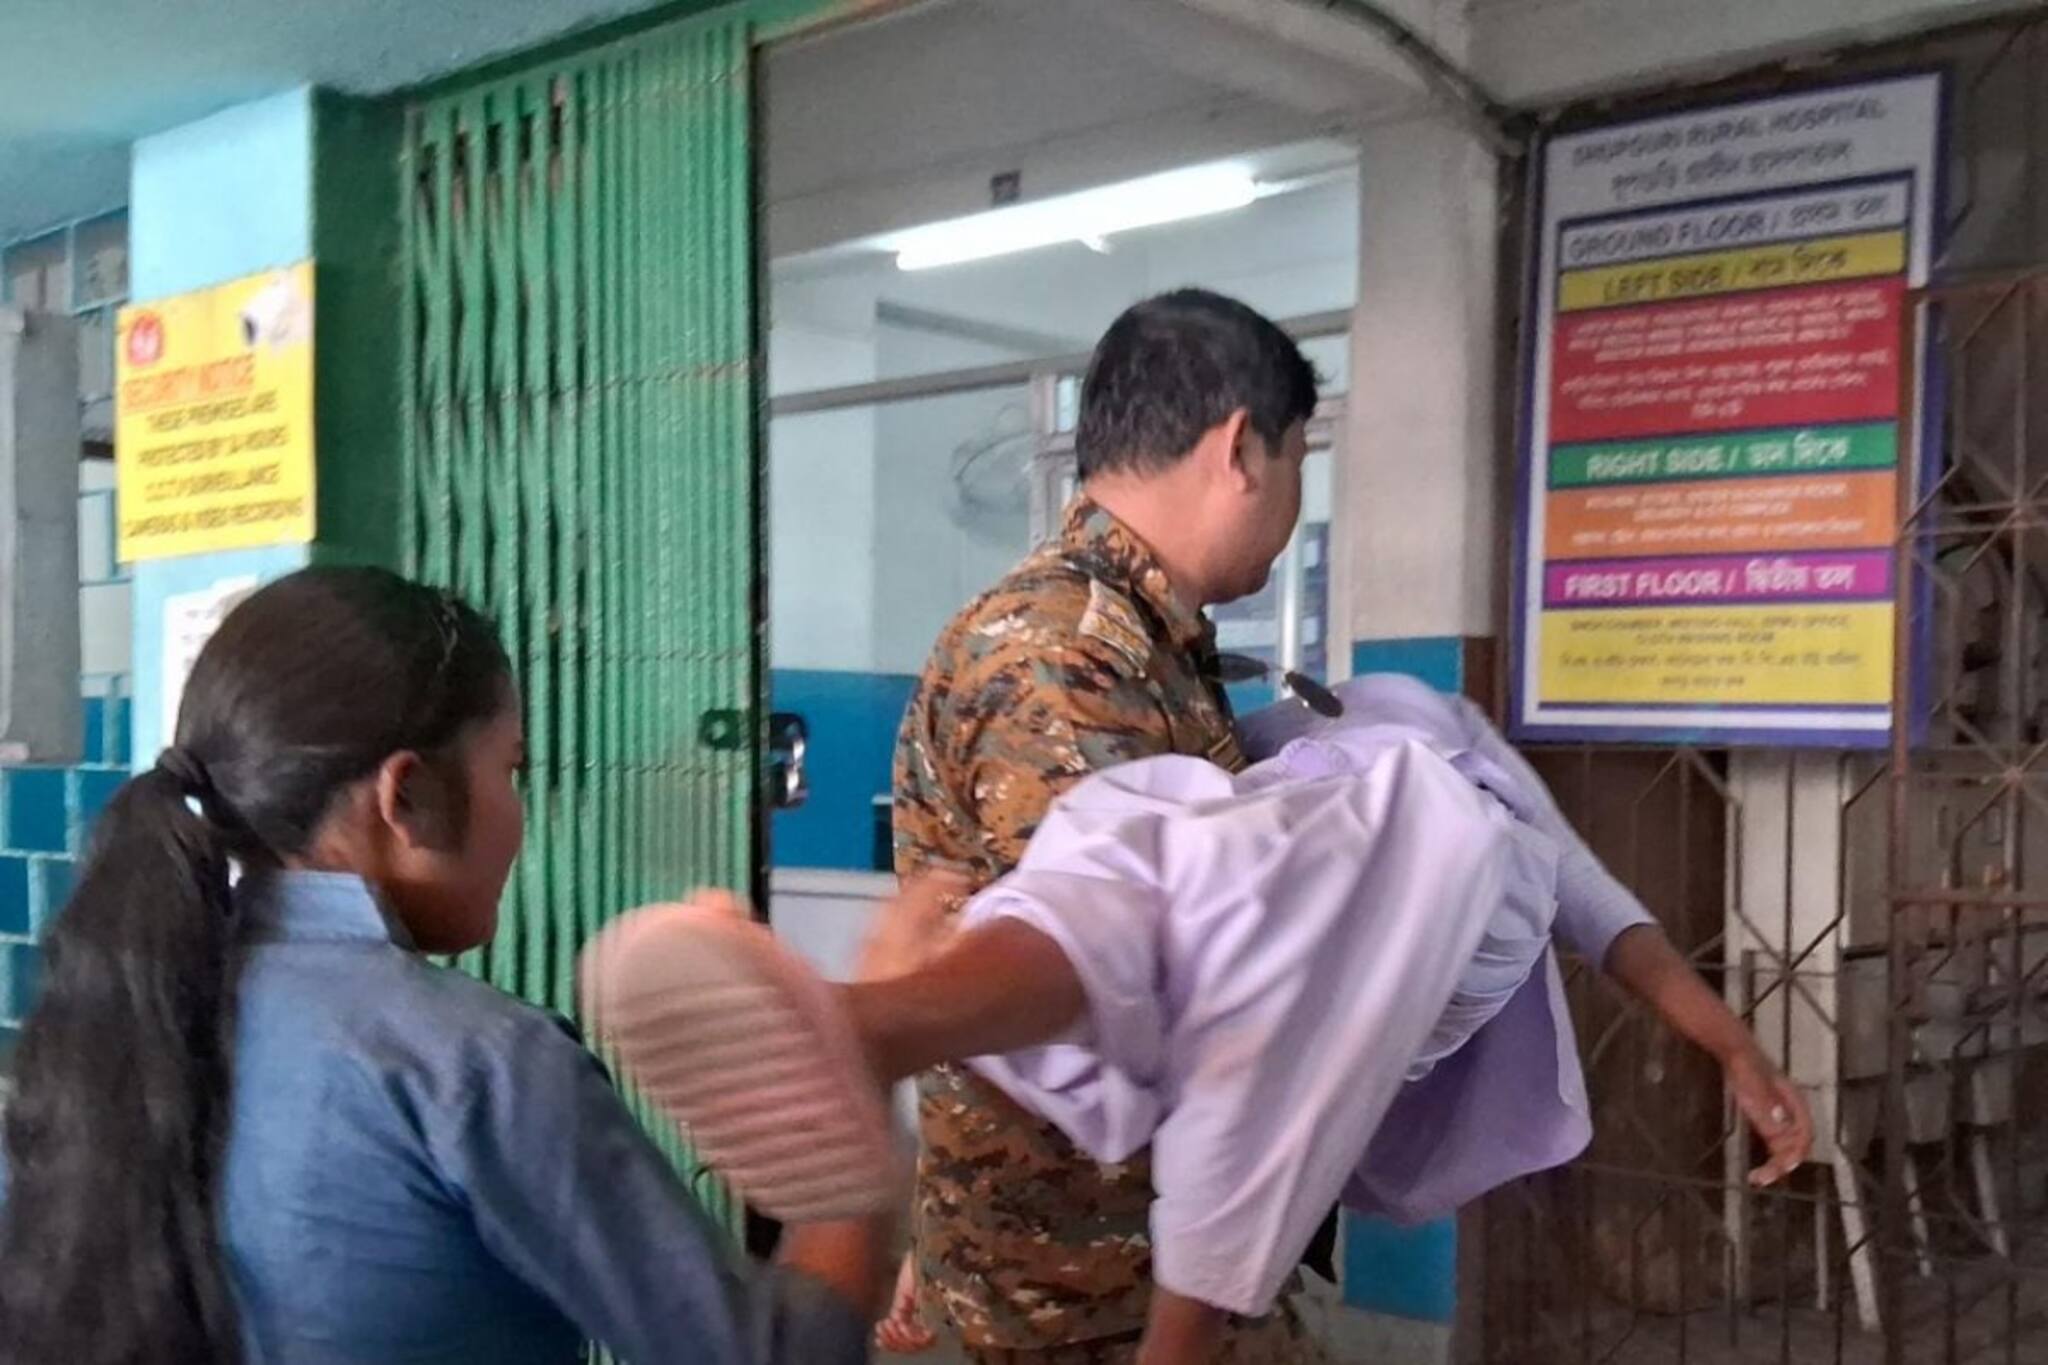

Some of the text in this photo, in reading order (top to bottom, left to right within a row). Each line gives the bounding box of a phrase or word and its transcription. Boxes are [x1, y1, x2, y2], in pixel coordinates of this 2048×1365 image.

[1768, 98, 1887, 136] HOSPITAL
[1568, 222, 1671, 263] GROUND
[1678, 211, 1766, 245] FLOOR
[1602, 267, 1666, 299] LEFT
[1668, 262, 1722, 292] SIDE
[1586, 451, 1660, 480] RIGHT
[1665, 445, 1726, 474] SIDE
[1727, 444, 1740, 470] /
[1563, 571, 1634, 600] FIRST
[1634, 568, 1724, 599] FLOOR
[1723, 566, 1739, 595] /
